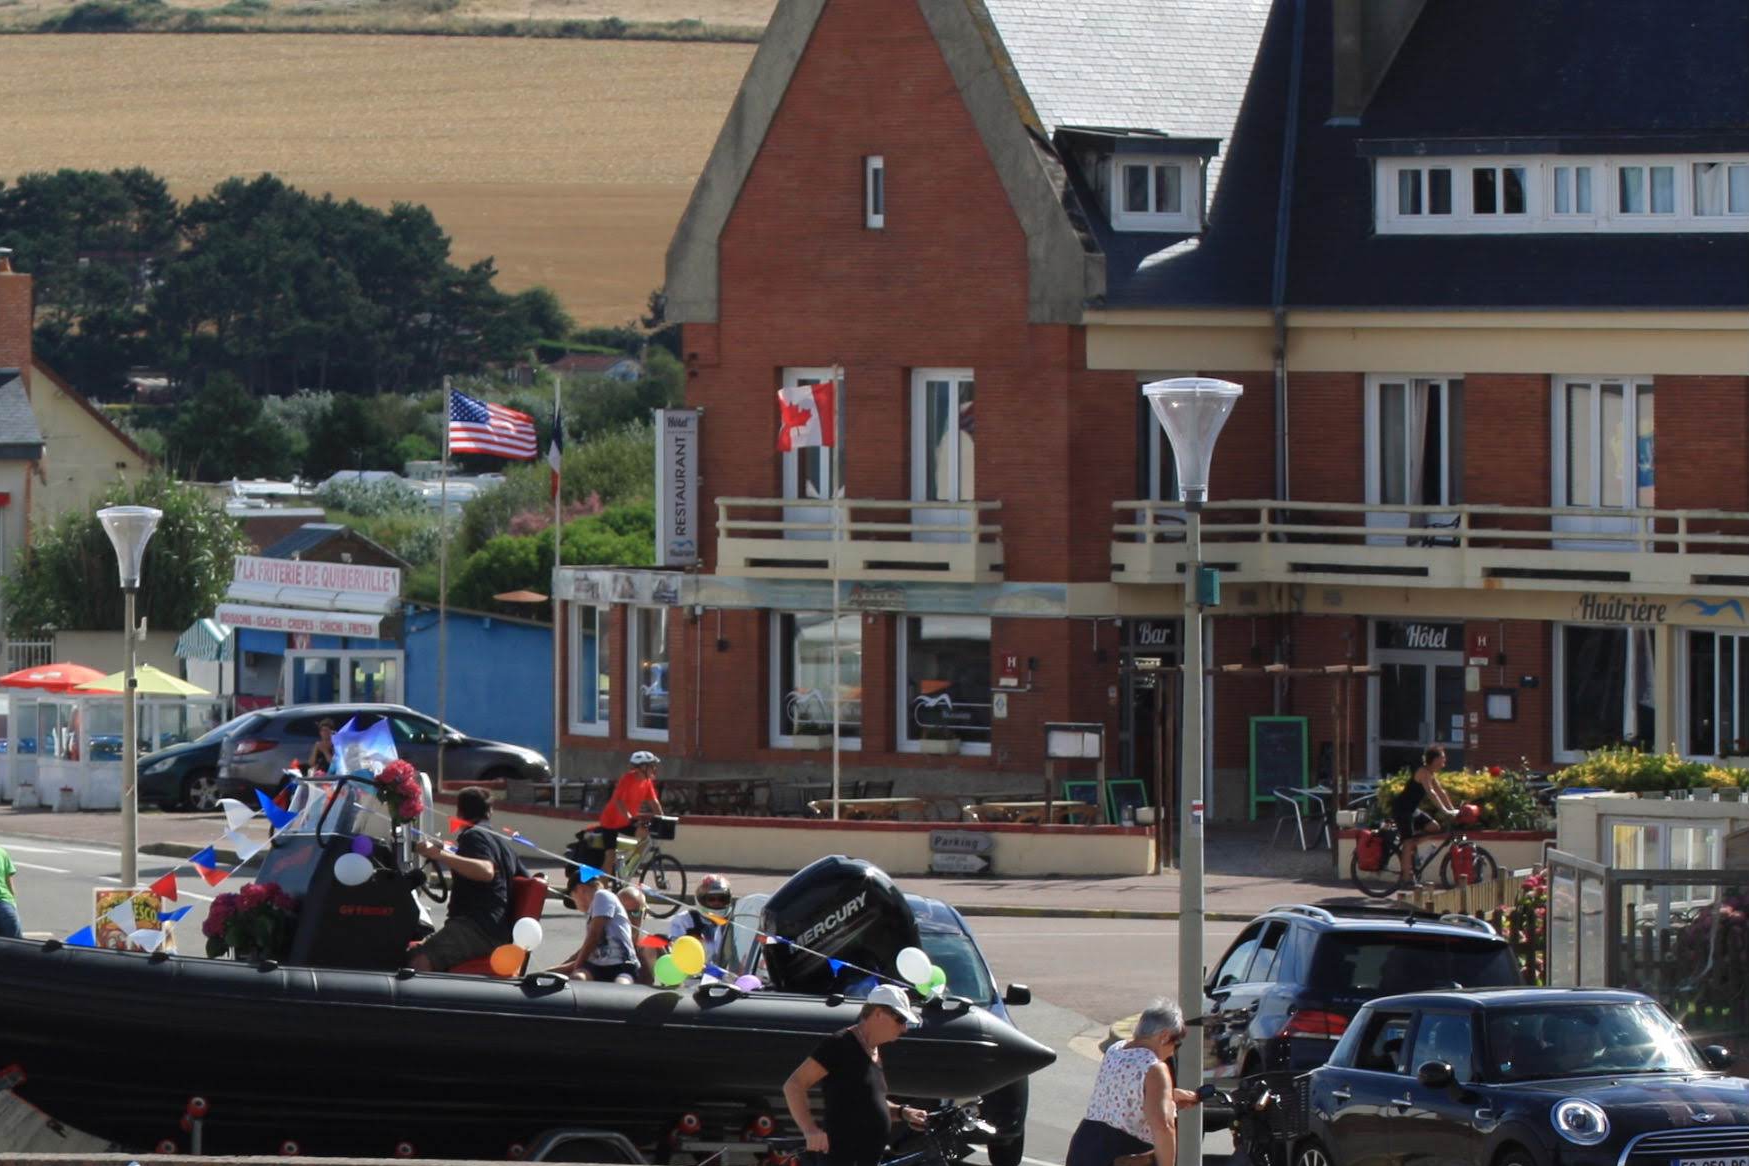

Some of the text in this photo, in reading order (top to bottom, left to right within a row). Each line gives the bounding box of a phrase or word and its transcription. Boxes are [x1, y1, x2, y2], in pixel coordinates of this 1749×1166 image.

[675, 436, 687, 536] RESTAURANT
[243, 560, 391, 592] LA FRITERIE DE QUIBERVILLE
[257, 615, 283, 629] GLACES
[320, 620, 344, 633] CHICHI
[348, 622, 373, 635] FRITES
[1138, 622, 1170, 645] Bar
[1406, 624, 1449, 648] Hôtel
[1477, 635, 1487, 647] H
[1006, 656, 1017, 668] H
[934, 836, 979, 849] Parking
